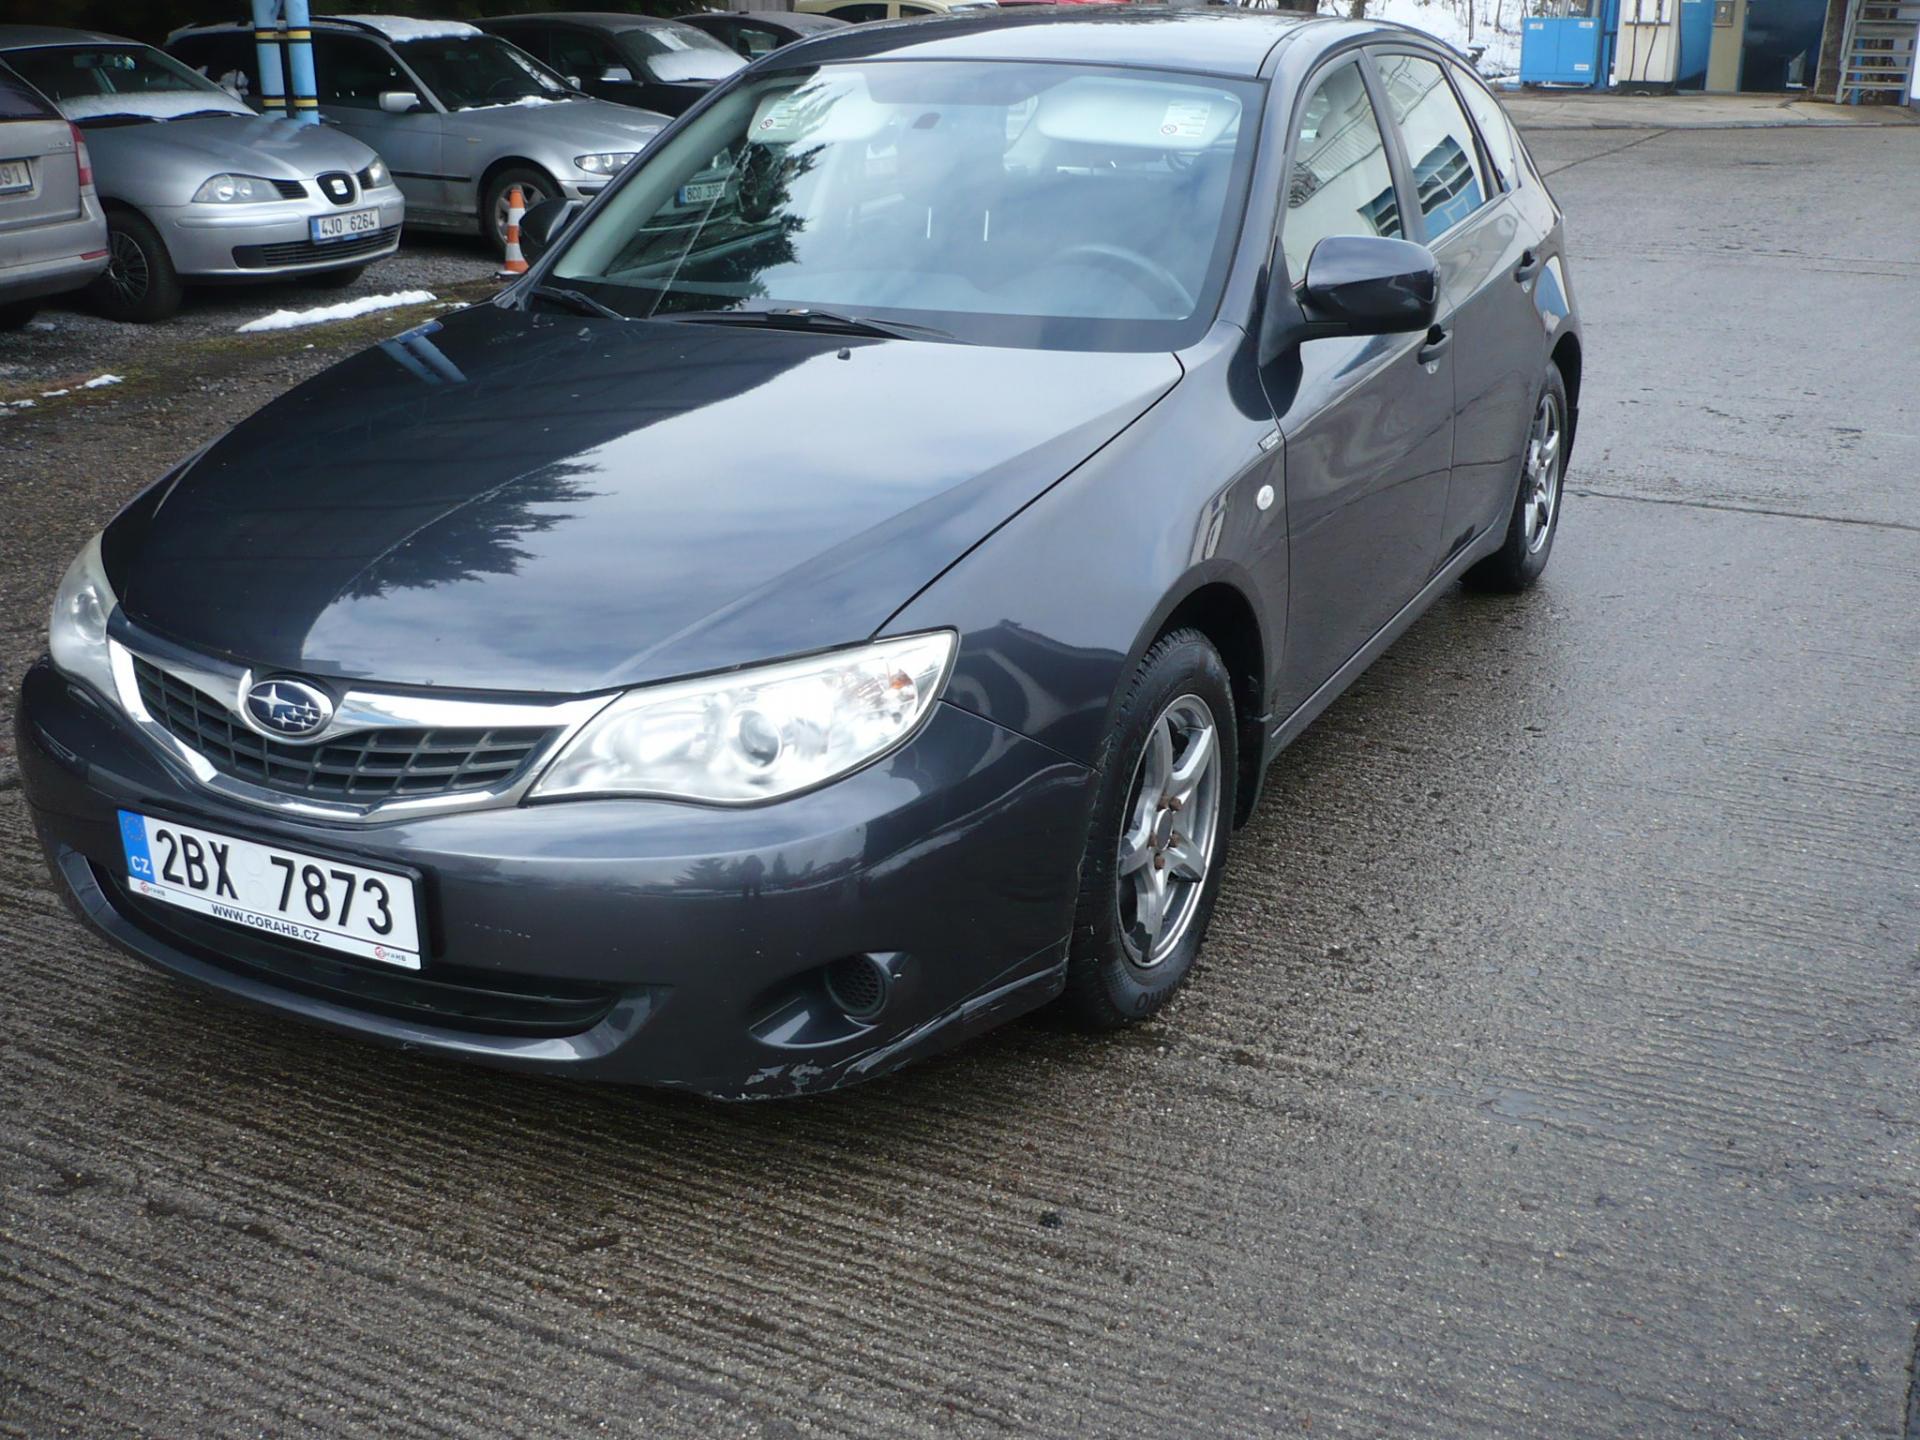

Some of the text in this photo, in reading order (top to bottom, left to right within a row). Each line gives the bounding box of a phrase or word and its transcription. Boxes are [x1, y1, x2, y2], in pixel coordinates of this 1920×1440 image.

[350, 212, 375, 231] 6264
[131, 855, 151, 874] CZ
[156, 828, 394, 936] 2BX 7873
[211, 903, 321, 943] WWW.CORAHB.CZ
